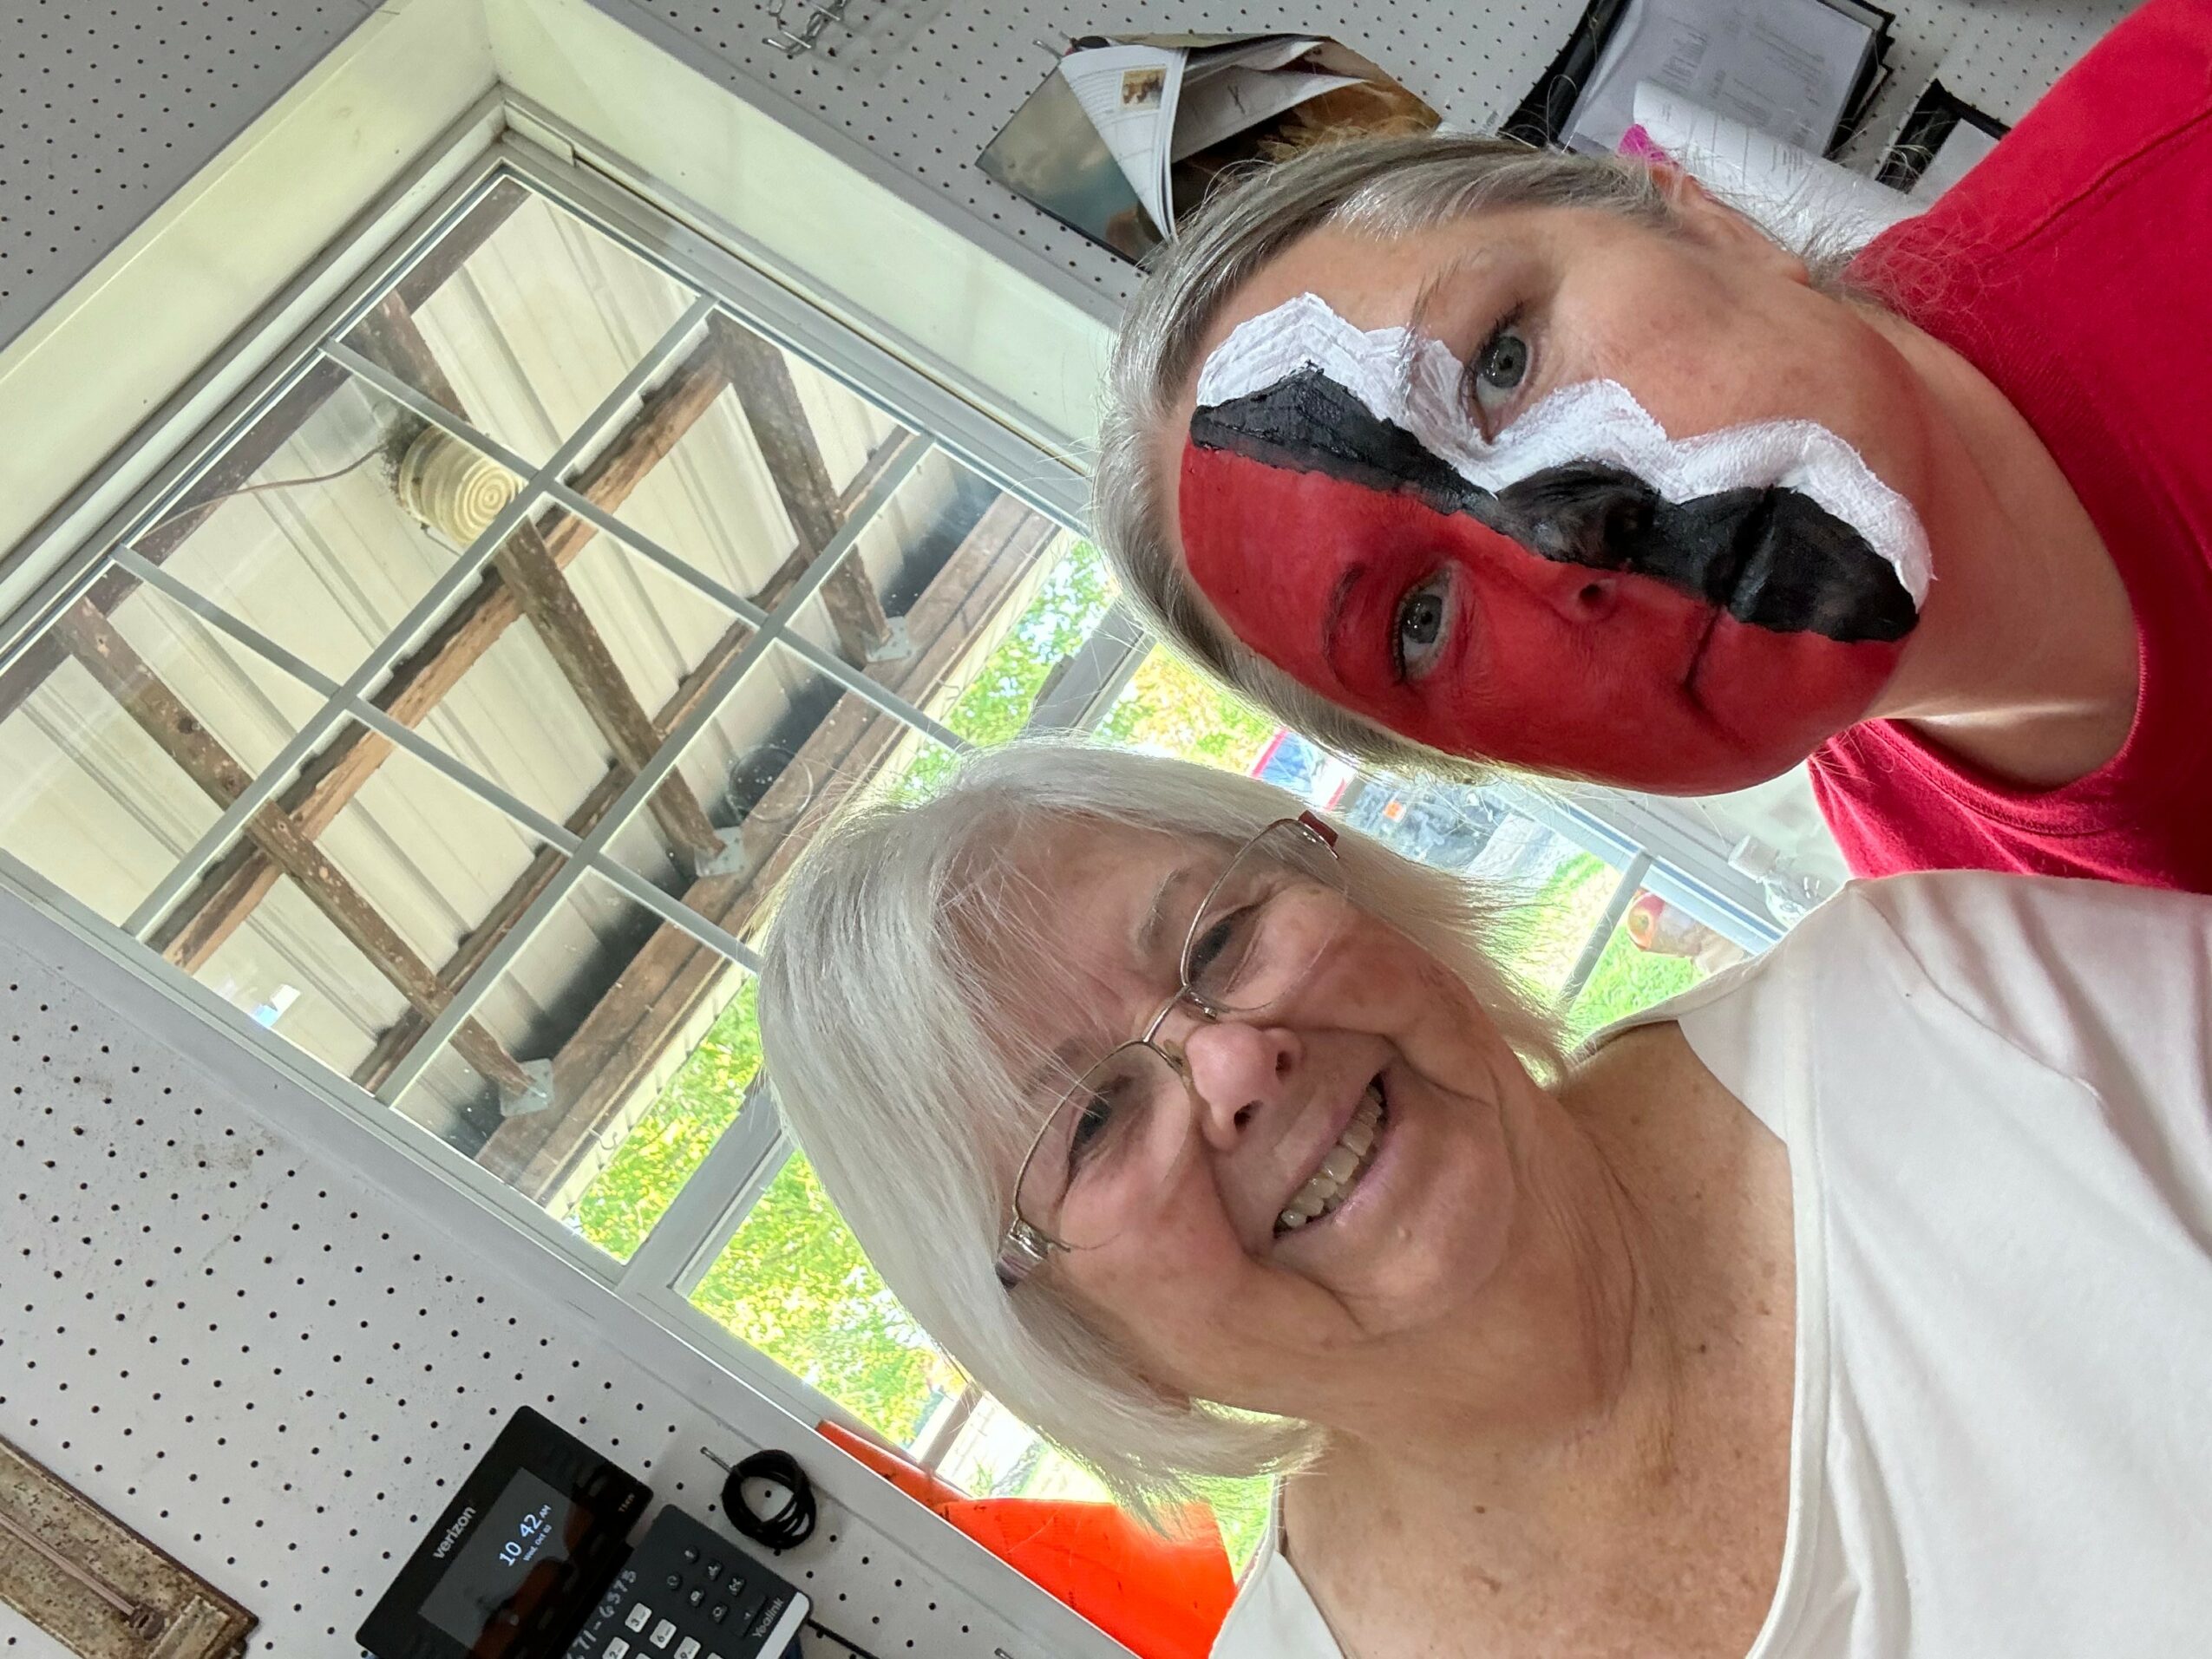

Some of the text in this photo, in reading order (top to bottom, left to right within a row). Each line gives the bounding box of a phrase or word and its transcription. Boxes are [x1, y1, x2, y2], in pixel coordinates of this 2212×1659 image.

[434, 1506, 476, 1559] verizon
[500, 1504, 552, 1566] 10 42 AM
[535, 1532, 547, 1545] Oct
[631, 1618, 640, 1627] 3
[751, 1597, 784, 1637] Yealink
[657, 1635, 665, 1643] 6
